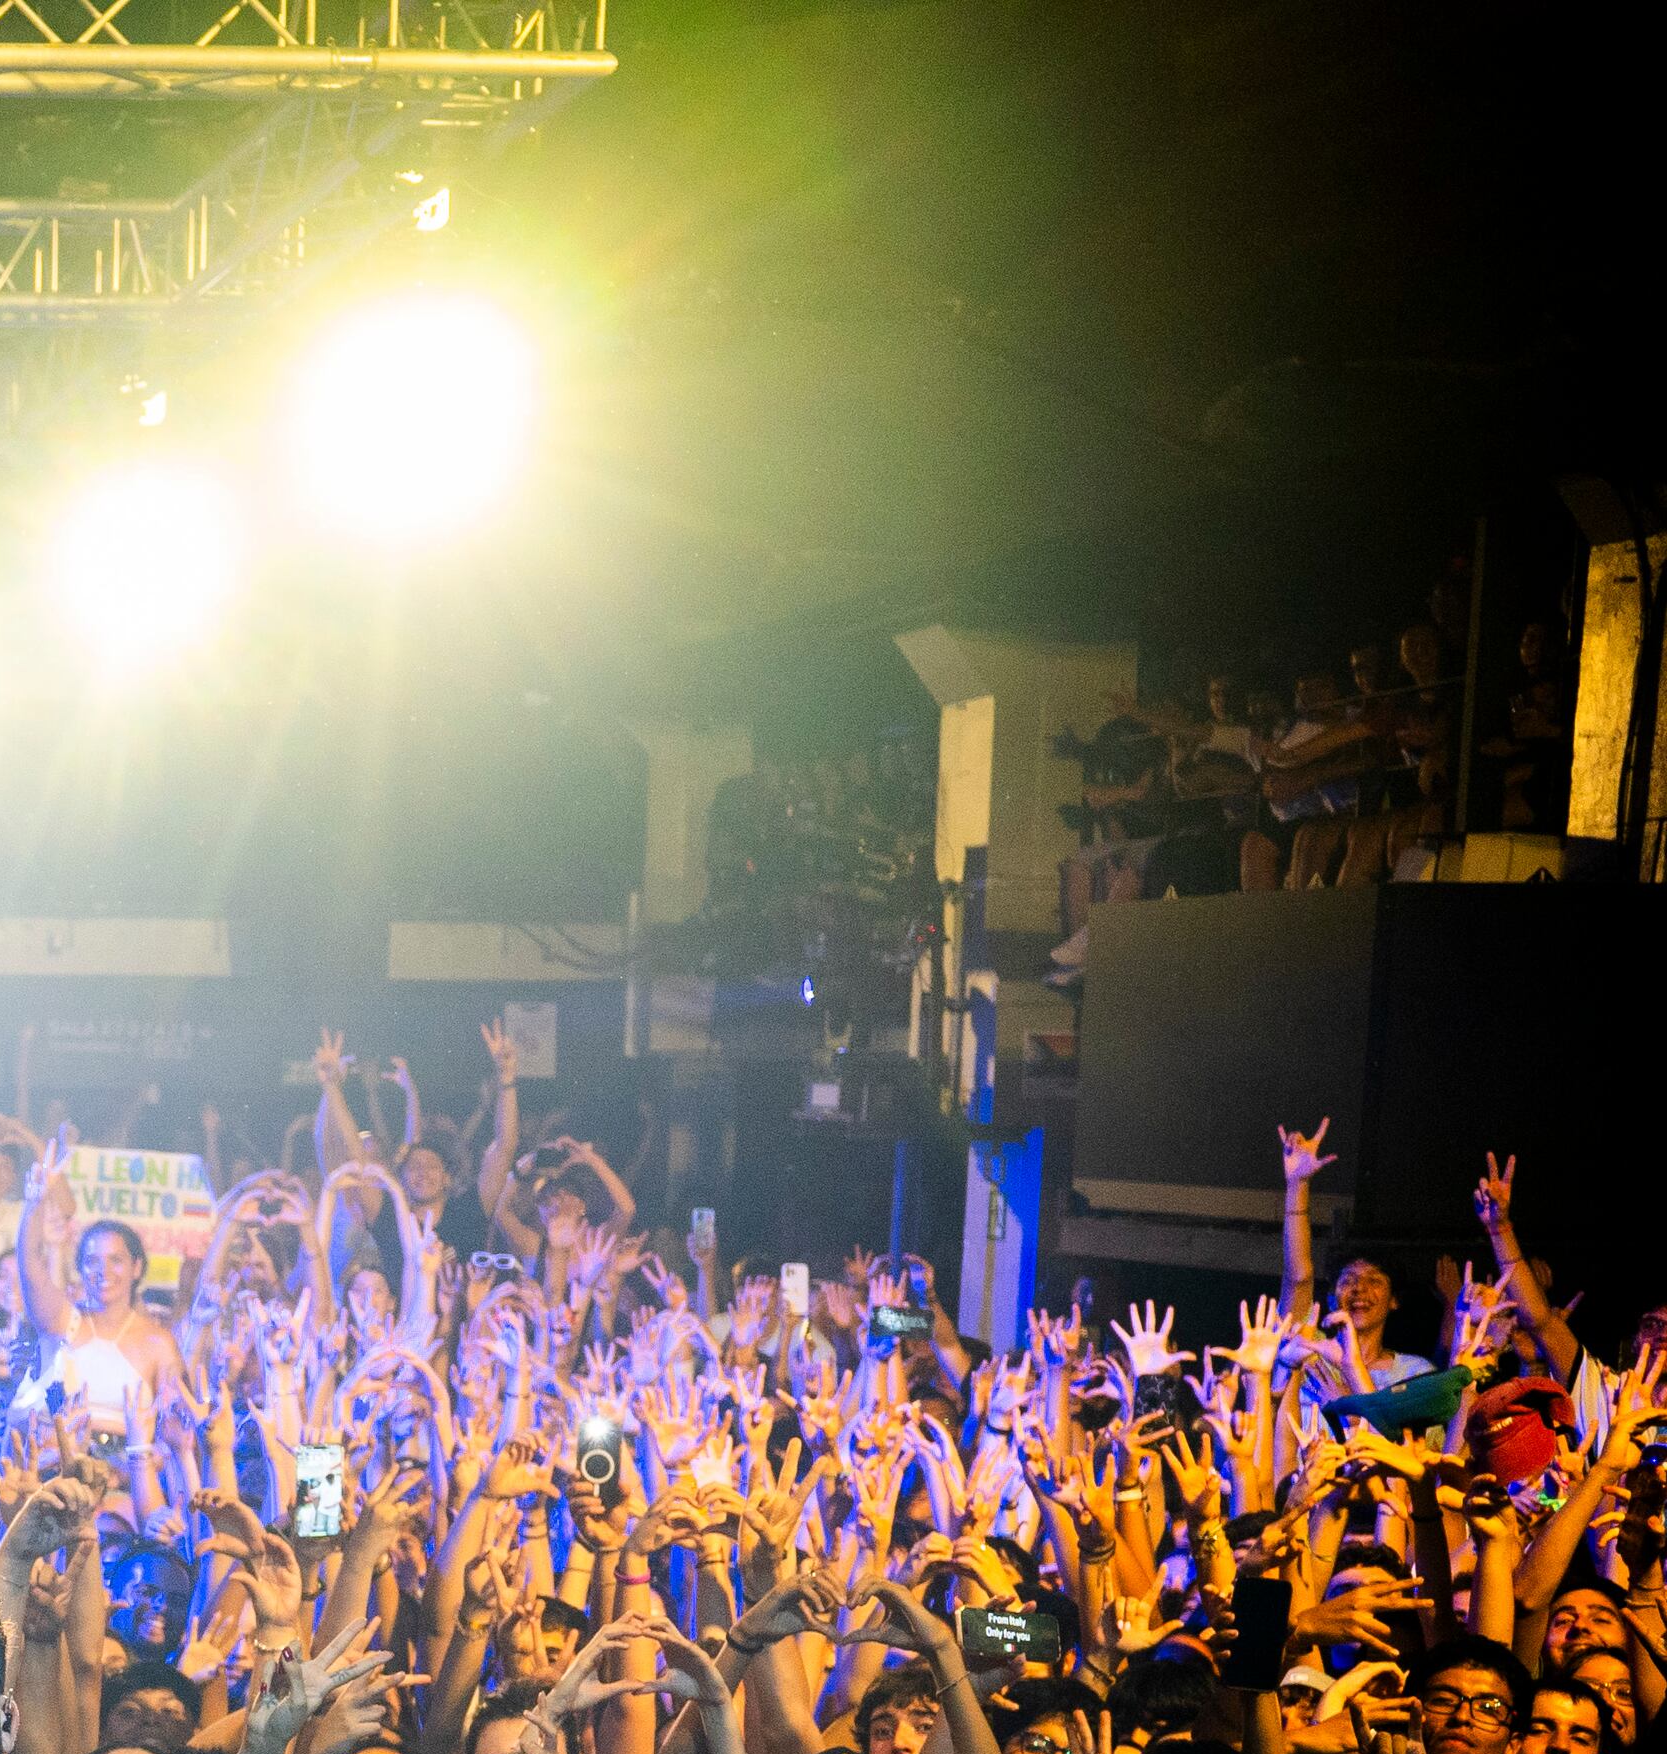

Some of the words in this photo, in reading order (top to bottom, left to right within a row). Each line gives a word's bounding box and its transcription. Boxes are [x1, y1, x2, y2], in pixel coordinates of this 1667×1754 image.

[82, 1185, 177, 1219] VUELTO
[987, 1612, 1009, 1625] From
[1009, 1615, 1027, 1629] Italy
[985, 1625, 1003, 1640] Only
[1003, 1628, 1016, 1640] for
[1016, 1632, 1031, 1643] you
